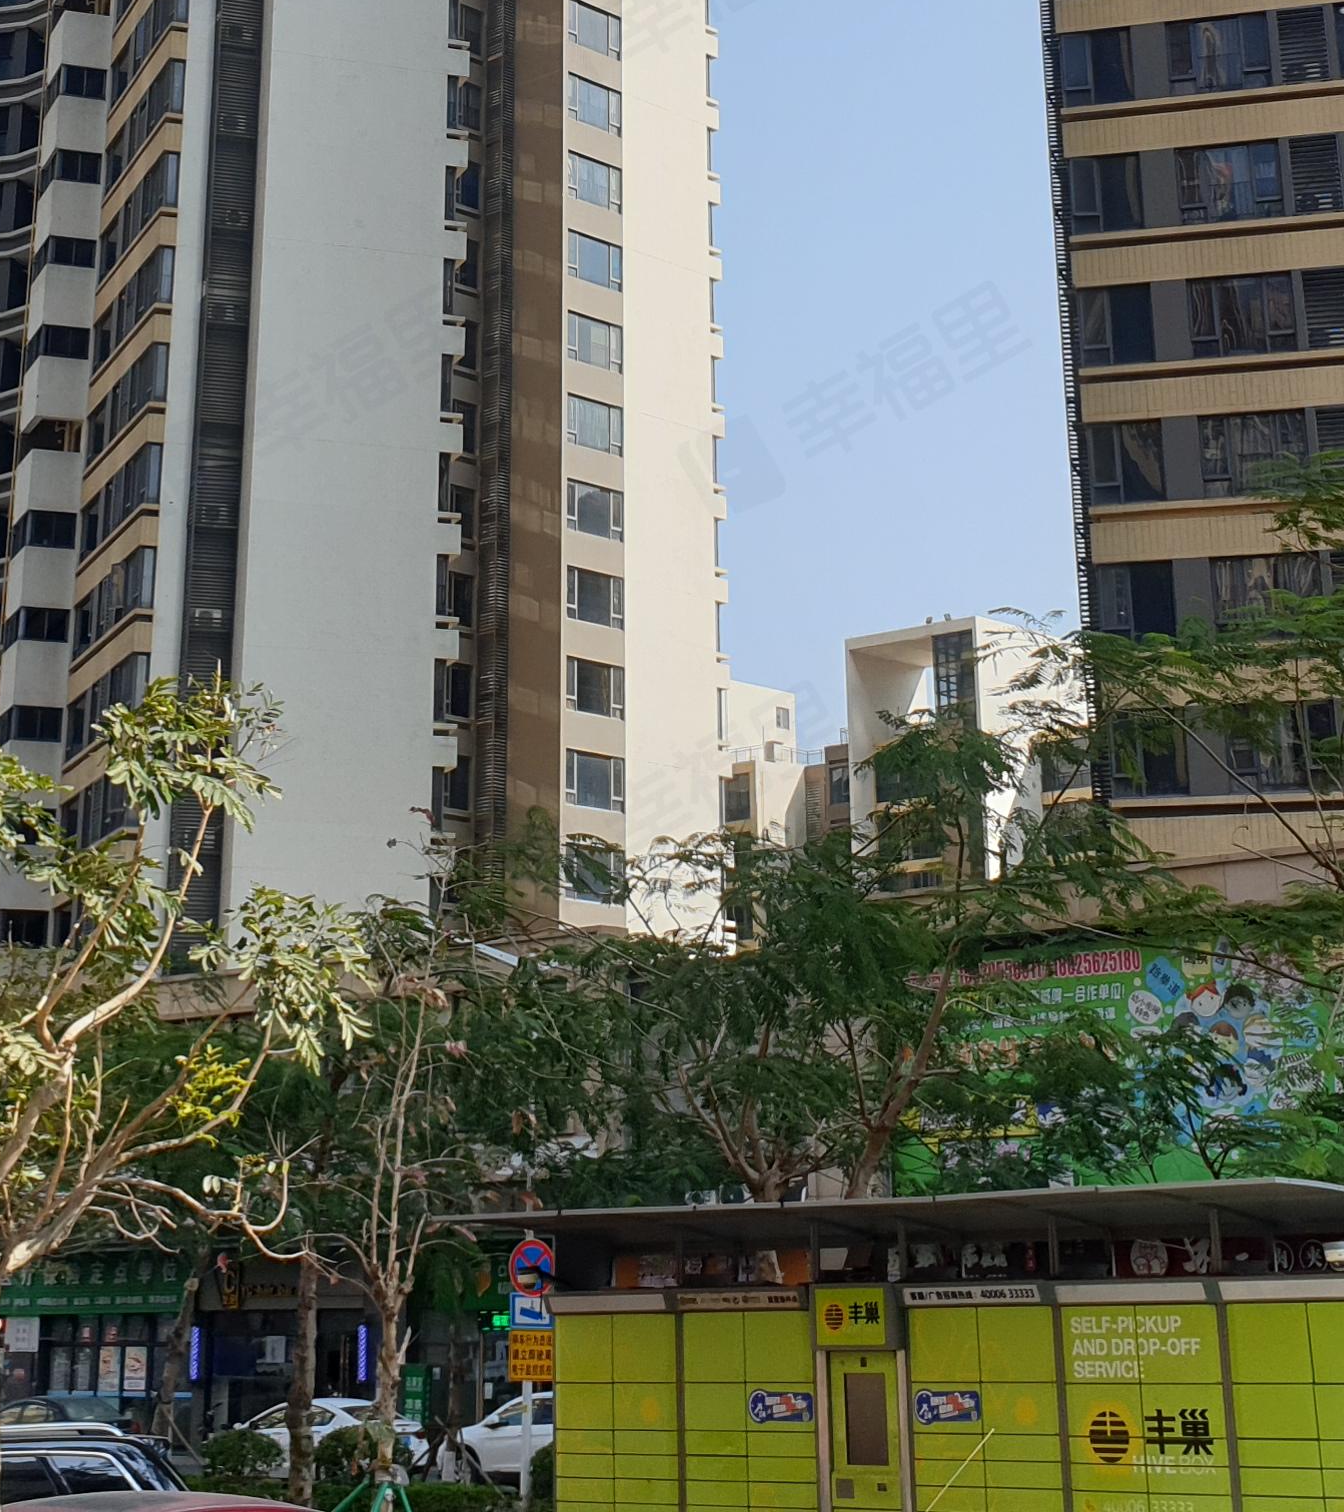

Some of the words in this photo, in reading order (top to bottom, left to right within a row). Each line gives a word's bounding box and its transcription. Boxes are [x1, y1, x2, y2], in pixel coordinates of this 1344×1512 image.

[848, 1301, 880, 1325] 丰巢
[1070, 1315, 1182, 1334] SELF-PICKUP
[1072, 1338, 1110, 1356] AND
[1112, 1337, 1201, 1356] DROP-OFF
[1073, 1360, 1145, 1378] SERVICE
[1144, 1408, 1214, 1455] 丰巢
[1132, 1455, 1177, 1475] HIVE
[1179, 1455, 1217, 1475] BOX
